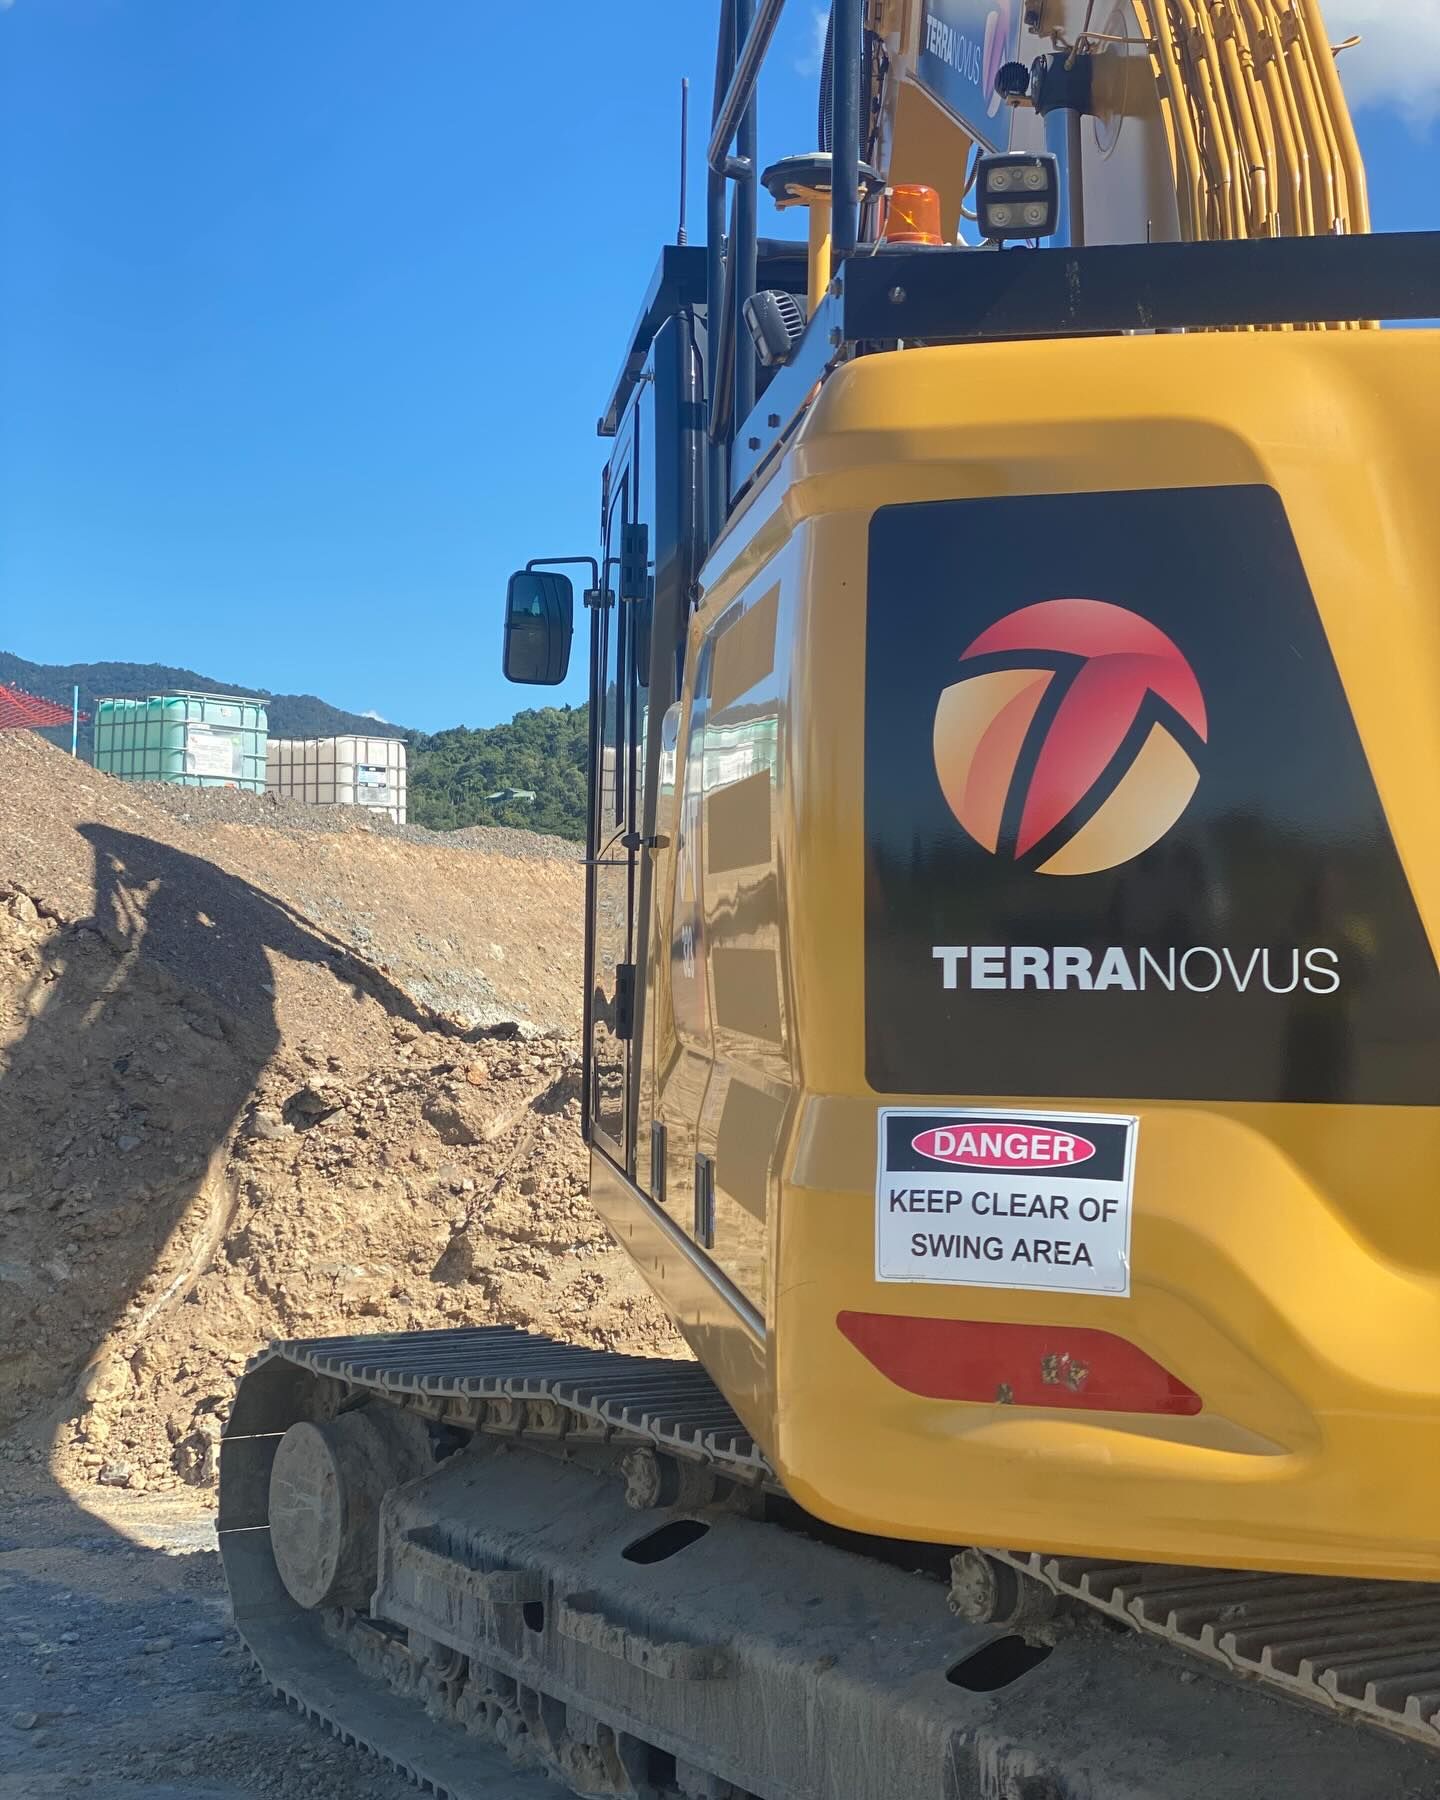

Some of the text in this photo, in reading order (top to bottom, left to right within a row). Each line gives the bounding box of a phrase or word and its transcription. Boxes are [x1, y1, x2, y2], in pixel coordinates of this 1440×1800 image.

[926, 14, 981, 85] TERRANOVUS
[932, 946, 1341, 994] TERRANOVUS
[934, 1131, 1076, 1162] DANGER
[889, 1189, 1119, 1223] KEEP CLEAR OF
[911, 1233, 1094, 1267] SWING AREA
